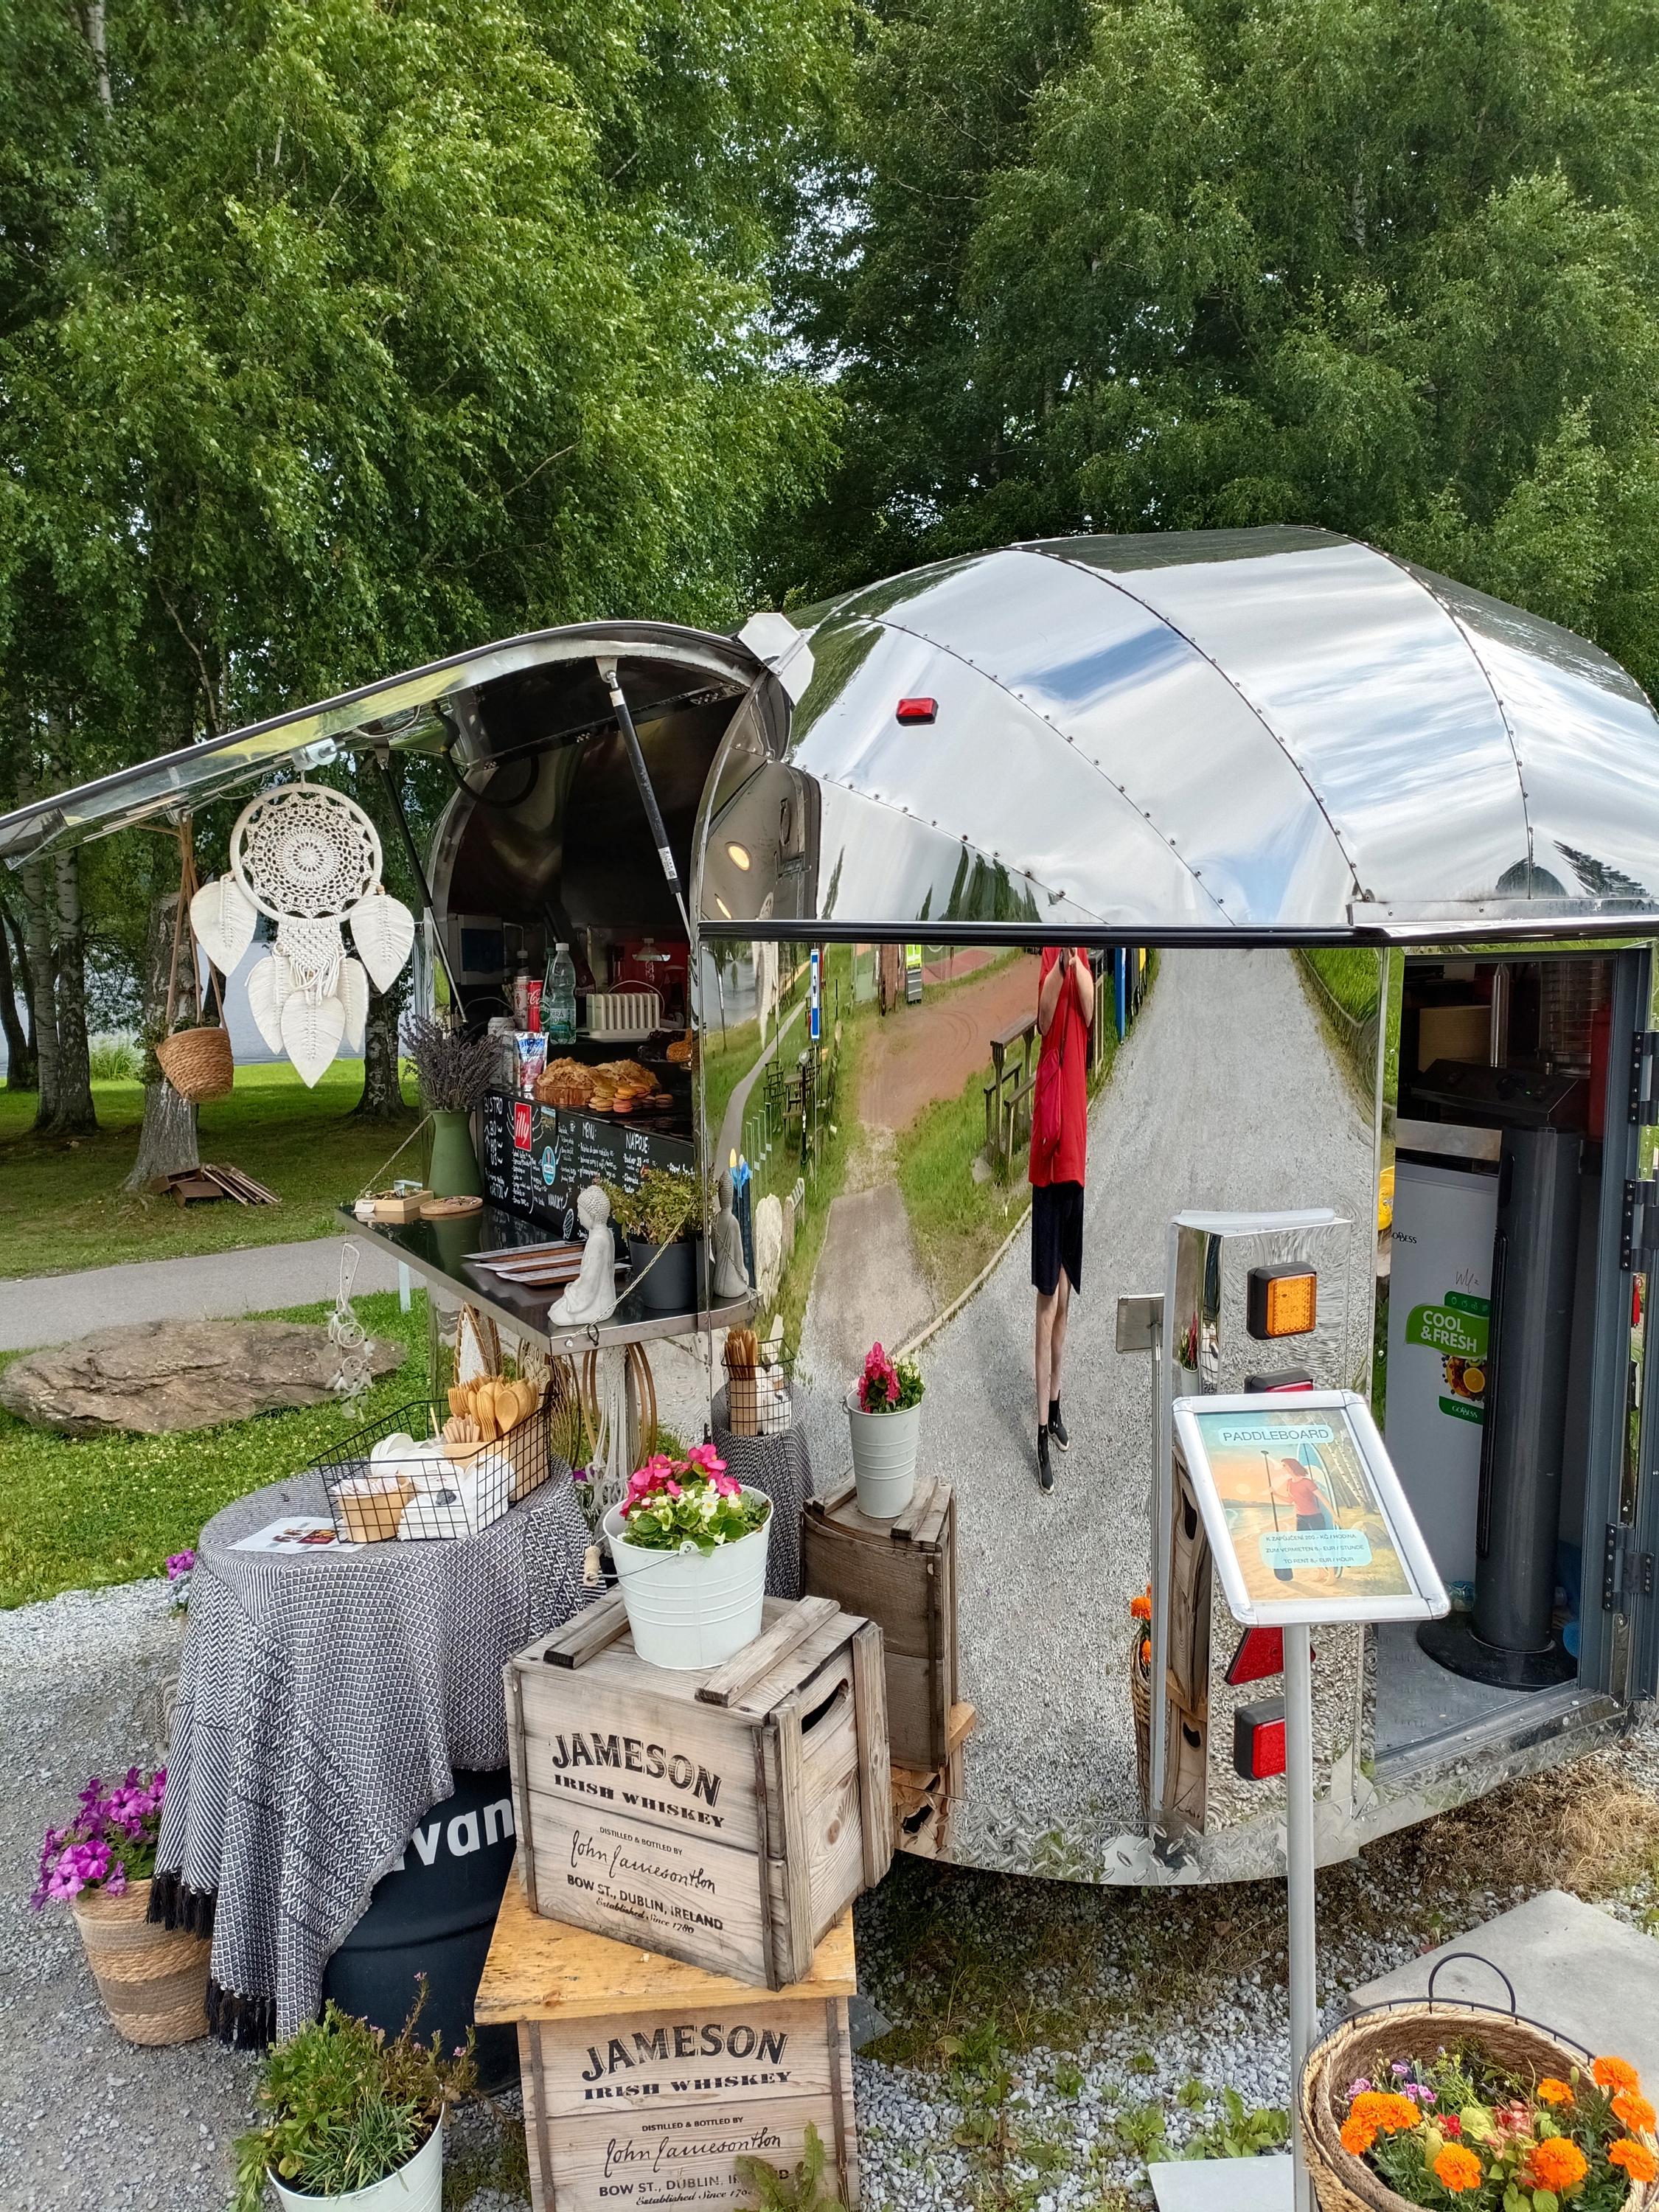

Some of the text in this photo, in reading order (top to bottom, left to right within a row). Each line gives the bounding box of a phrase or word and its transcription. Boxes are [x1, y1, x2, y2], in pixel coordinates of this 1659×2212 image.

[484, 1096, 504, 1115] BISTRO
[515, 1111, 529, 1145] illy
[1391, 1231, 1417, 1244] ODDESS
[1422, 1310, 1464, 1334] COOL
[1420, 1325, 1478, 1352] &FRESH
[1222, 1429, 1329, 1441] PADDLEBOARD
[552, 1733, 723, 1808] JAMESON
[554, 1774, 725, 1828] IRISH WHISKEY
[392, 1799, 515, 1871] van
[571, 1830, 608, 1868] John
[599, 1826, 683, 1856] DISTILLED & BOTTLED BY
[567, 1874, 594, 1892] BOW
[619, 1889, 667, 1916] DUBLIN,
[669, 1904, 724, 1931] IRELAND
[596, 1896, 646, 1919] Established
[672, 1921, 695, 1934] 1780
[581, 2023, 790, 2081] JAMESON
[584, 2070, 792, 2101] IRISH WHISKEY
[641, 2122, 684, 2132] DISTILLED
[694, 2118, 731, 2128] BOTTLED
[732, 2116, 744, 2124] BY
[603, 2138, 651, 2178] John
[599, 2183, 635, 2197] BOW
[666, 2175, 724, 2191] DUBLIN,
[636, 2194, 695, 2206] Established
[698, 2188, 727, 2202] Since
